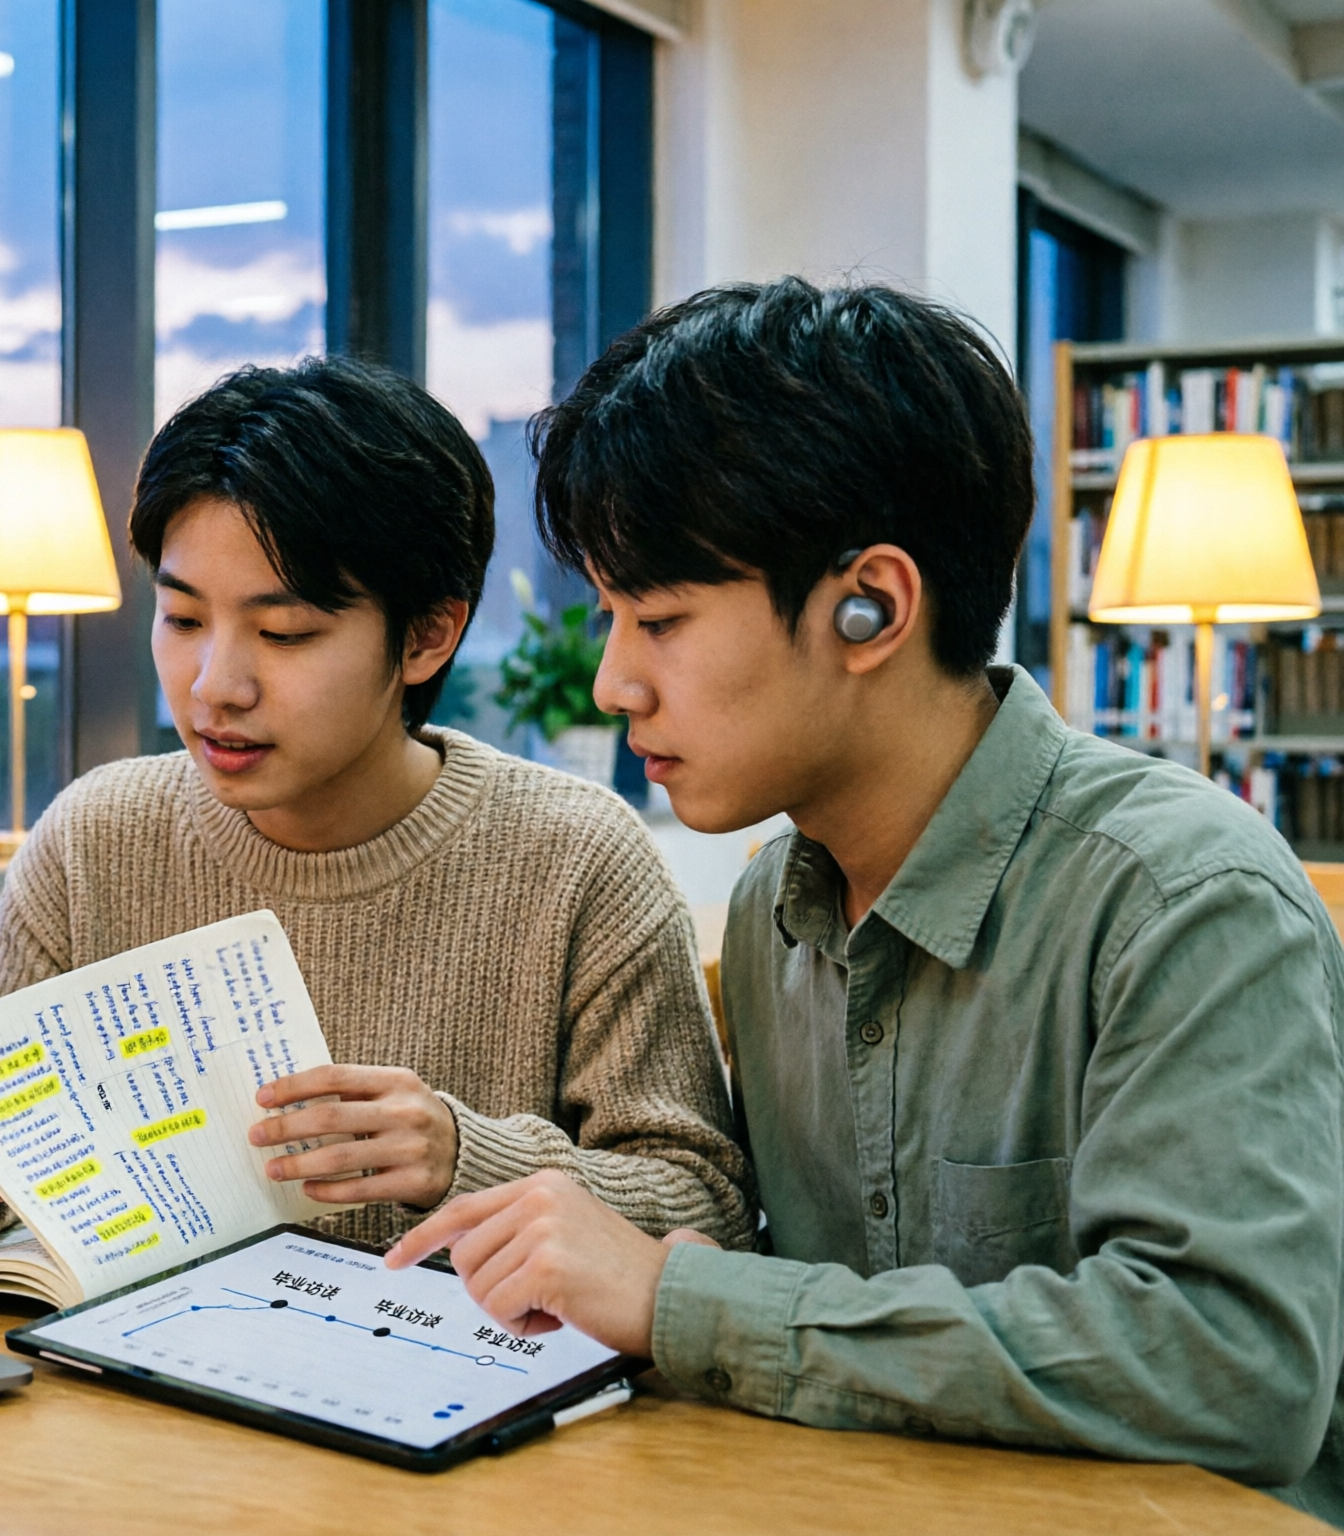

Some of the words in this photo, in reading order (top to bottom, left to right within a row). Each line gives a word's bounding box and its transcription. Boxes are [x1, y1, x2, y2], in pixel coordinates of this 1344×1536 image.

[272, 1270, 342, 1301] 毕业访谈
[374, 1298, 444, 1329] 毕业访谈
[472, 1325, 546, 1358] 毕业访谈
